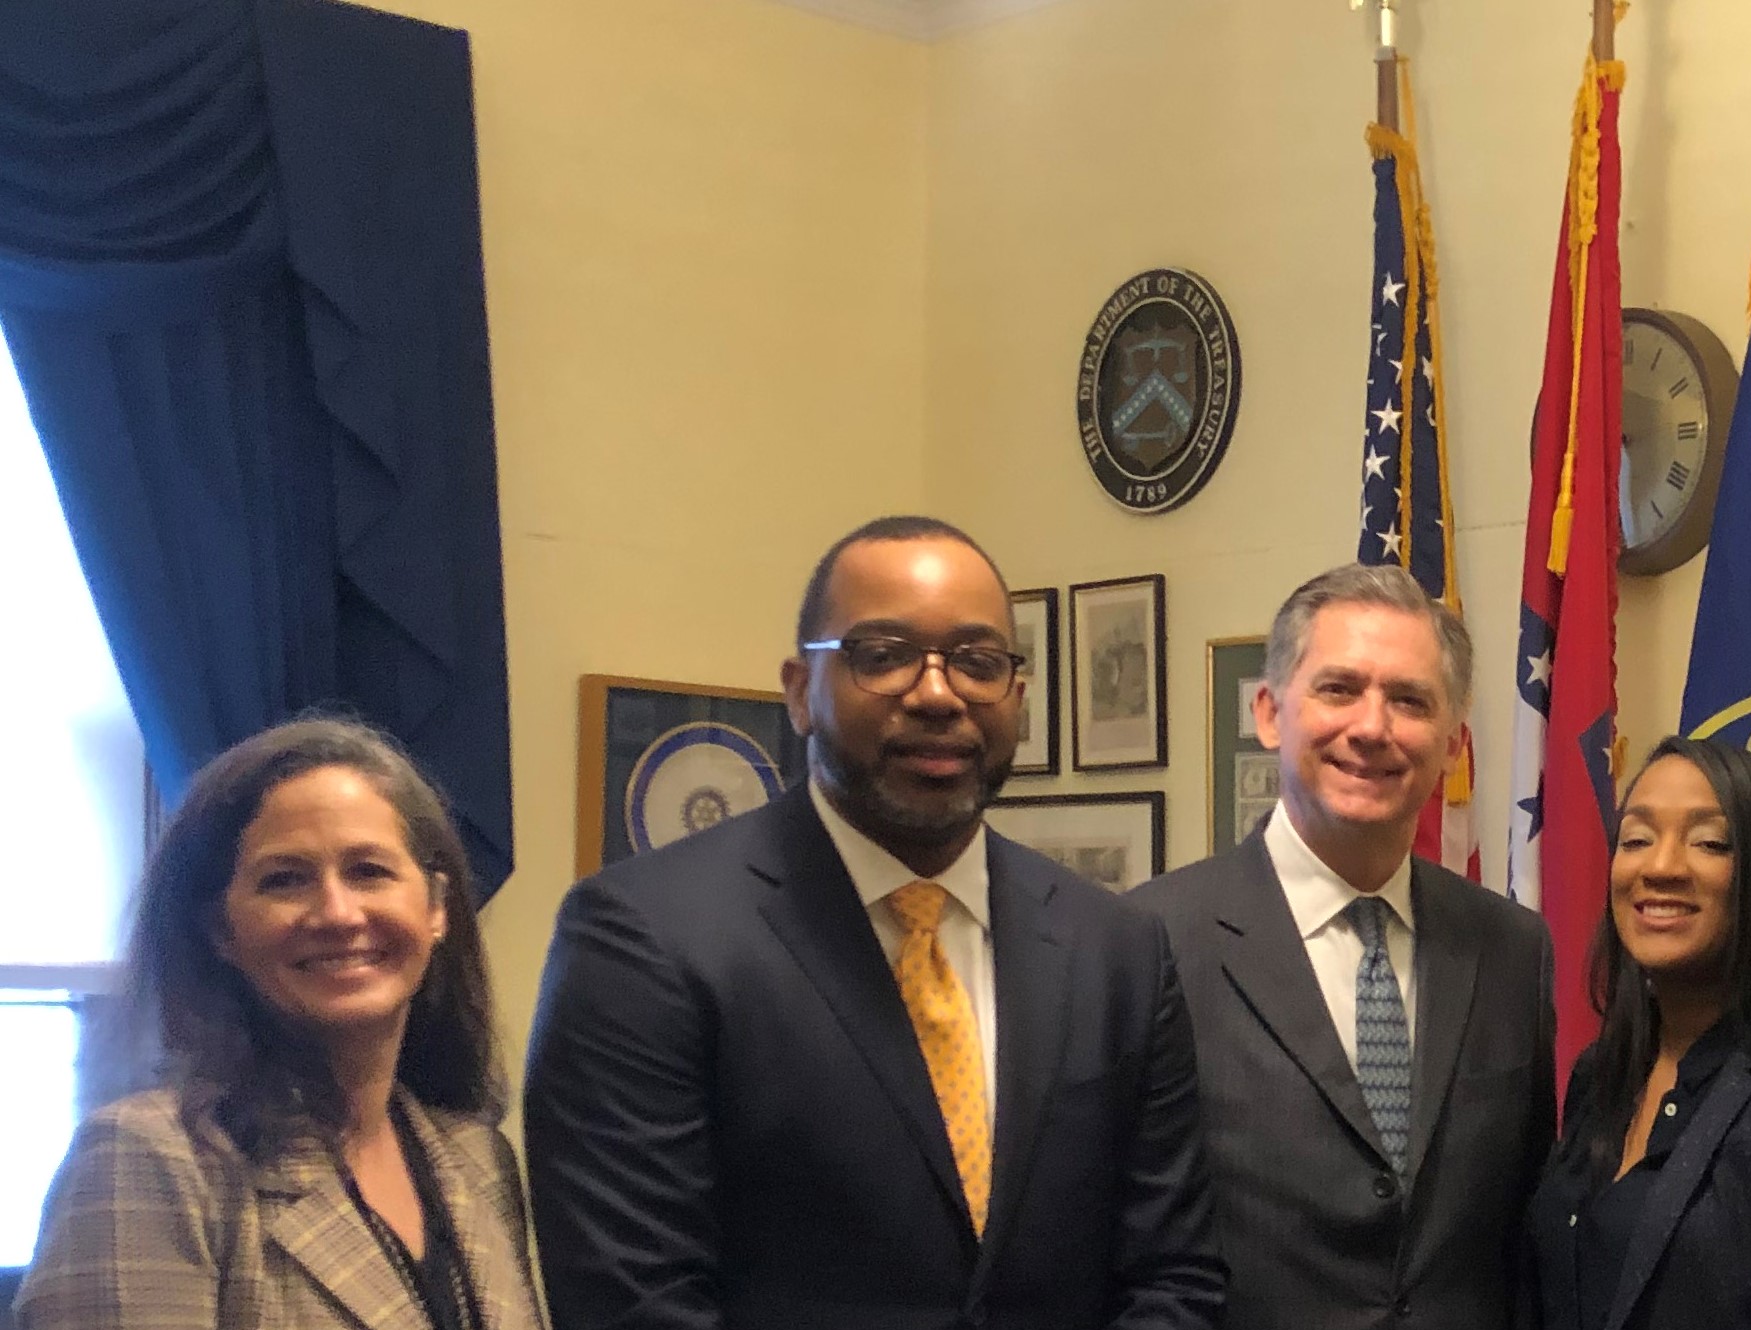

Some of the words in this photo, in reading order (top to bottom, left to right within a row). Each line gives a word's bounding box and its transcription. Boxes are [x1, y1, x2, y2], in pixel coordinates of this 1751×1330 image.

[1156, 274, 1177, 295] OF
[1185, 284, 1213, 323] THE
[1079, 276, 1151, 402] DEPARTMENT
[1196, 325, 1228, 457] TREASURY
[1081, 416, 1101, 464] THE
[1125, 482, 1168, 503] 1789
